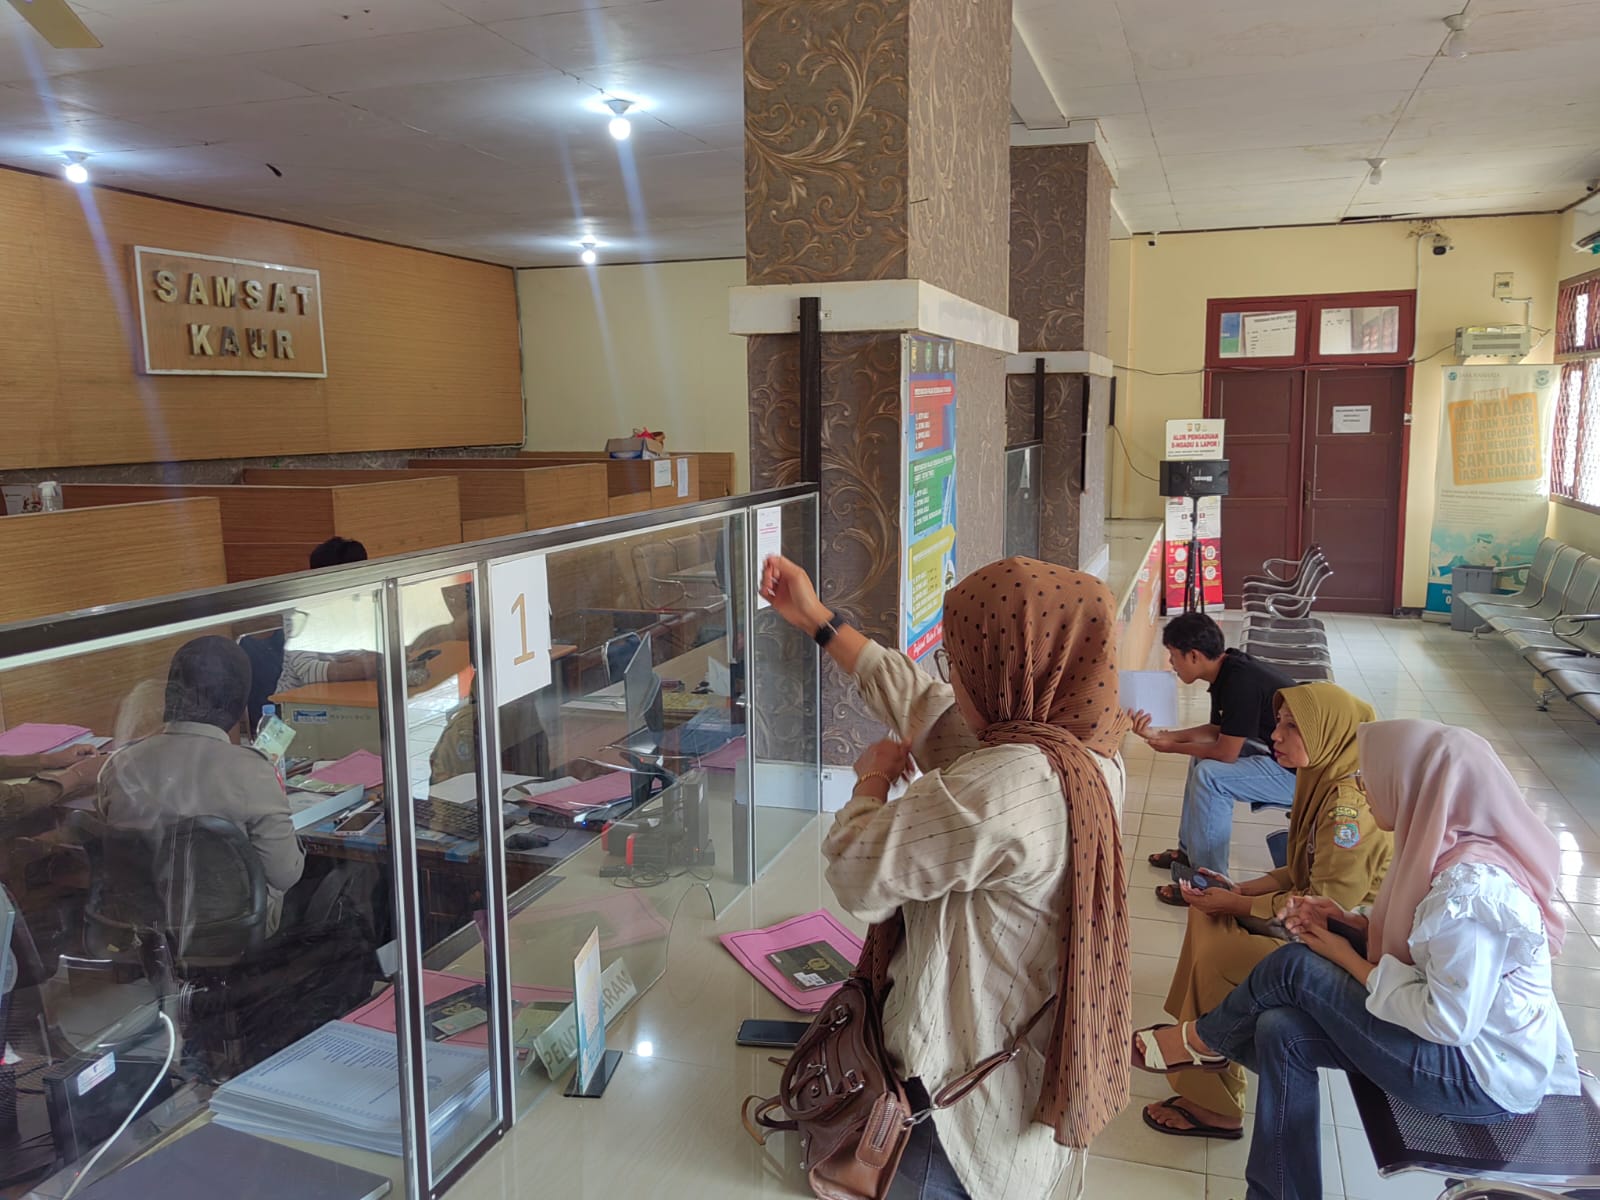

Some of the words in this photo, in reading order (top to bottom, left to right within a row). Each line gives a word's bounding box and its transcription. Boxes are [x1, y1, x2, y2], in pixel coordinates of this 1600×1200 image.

[154, 270, 313, 315] SAMSAT
[189, 323, 295, 360] KAUR
[1454, 398, 1533, 421] MINTALAH
[1502, 414, 1535, 427] POLISI
[1188, 432, 1219, 440] PENGADUAN
[1457, 447, 1537, 469] SANTUNAN
[1459, 468, 1484, 481] JASA
[1487, 464, 1537, 480] RAHARJA
[510, 592, 536, 666] 1
[543, 970, 632, 1069] PENARAN
